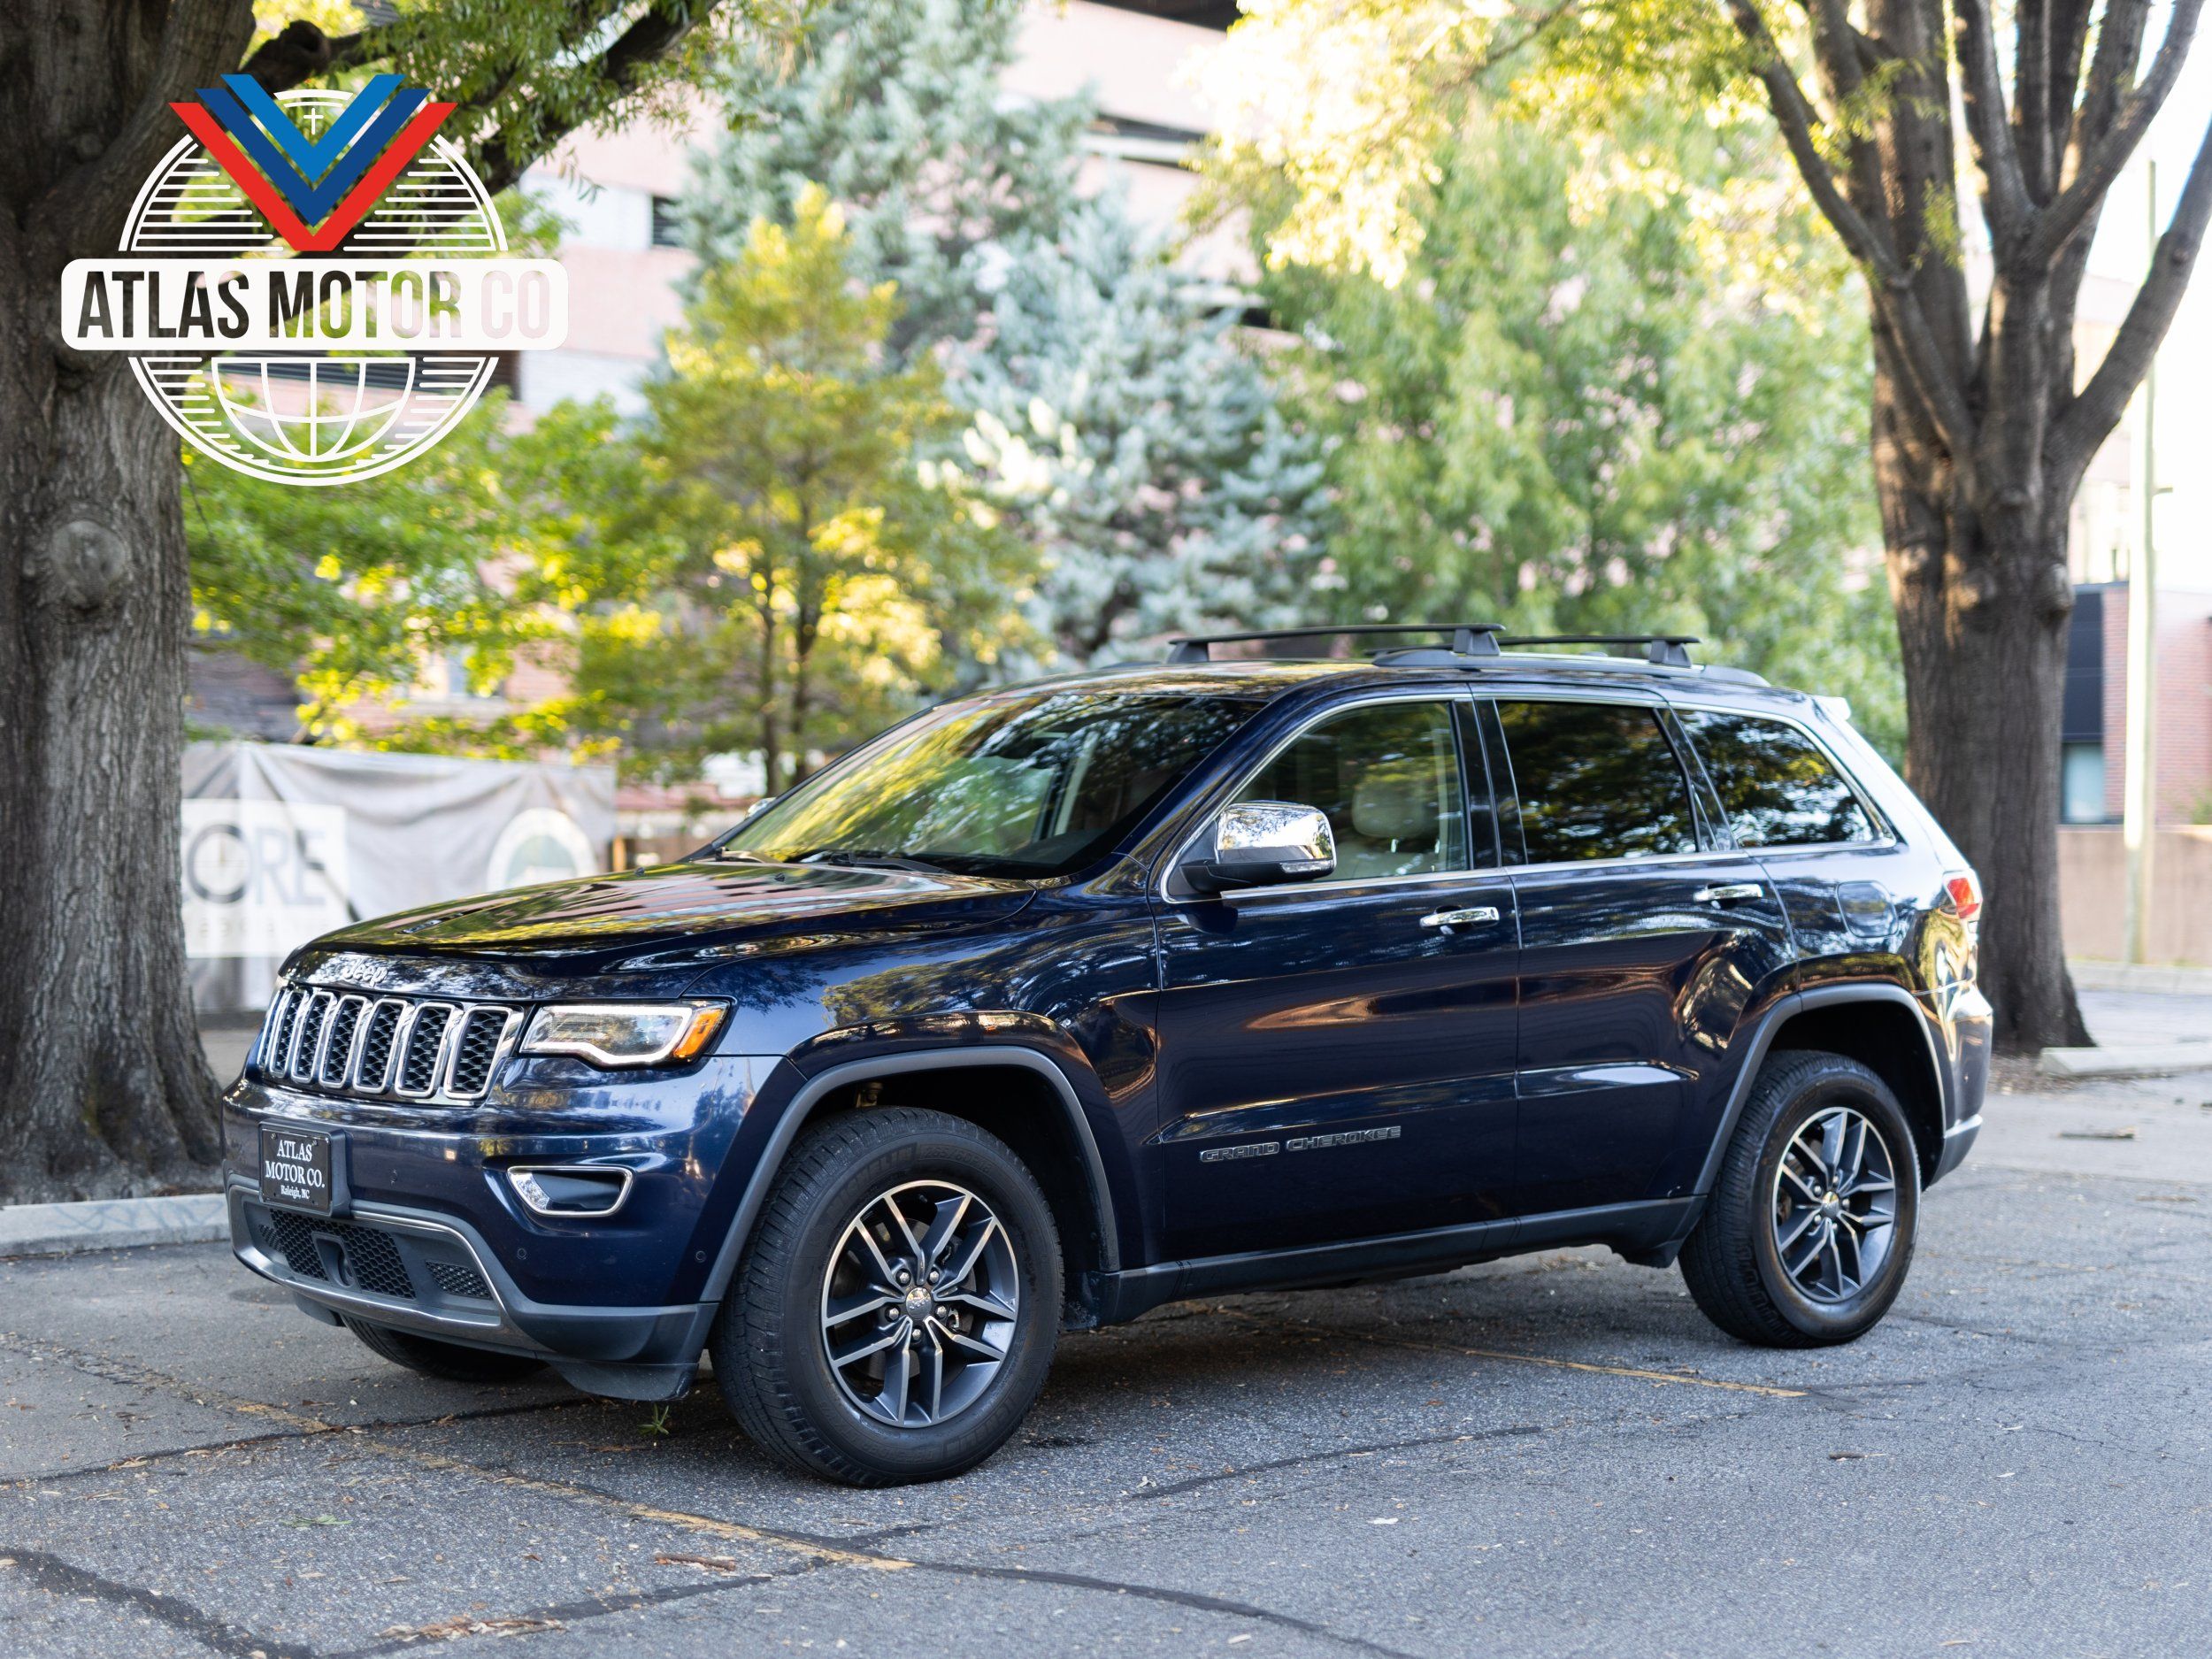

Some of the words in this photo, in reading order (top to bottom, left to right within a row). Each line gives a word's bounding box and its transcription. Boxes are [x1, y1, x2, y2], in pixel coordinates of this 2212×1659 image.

[181, 823, 326, 906] ORE
[342, 958, 388, 987] Jeep
[276, 1139, 313, 1163] ATLAS
[1200, 1141, 1280, 1163] GRAND
[1286, 1125, 1402, 1151] CHEROKEE
[265, 1160, 306, 1185] MOTOR
[306, 1168, 326, 1188] CO.
[301, 1188, 311, 1200] NC
